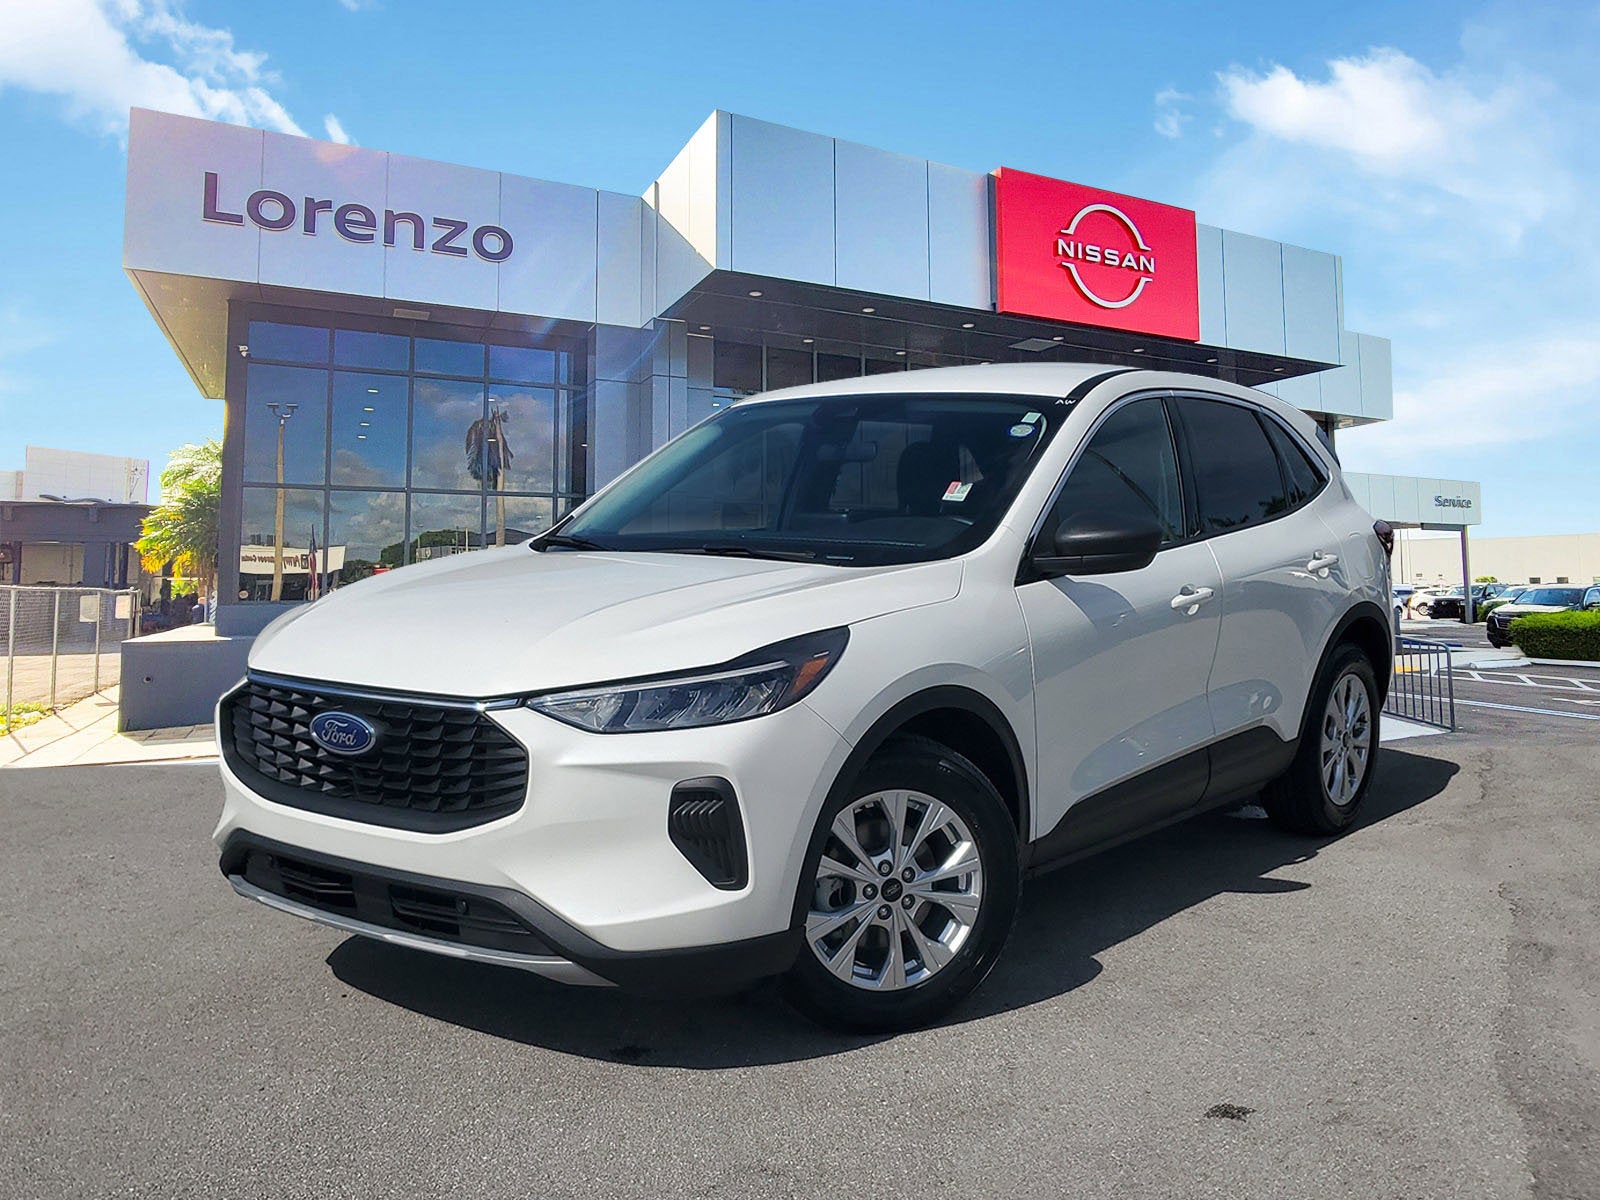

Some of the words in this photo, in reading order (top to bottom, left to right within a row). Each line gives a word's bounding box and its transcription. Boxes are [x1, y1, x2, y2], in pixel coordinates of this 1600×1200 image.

[202, 171, 514, 262] Lorenzo
[1057, 238, 1155, 273] NISSAN
[1434, 495, 1472, 509] Service
[321, 719, 357, 746] Ford
